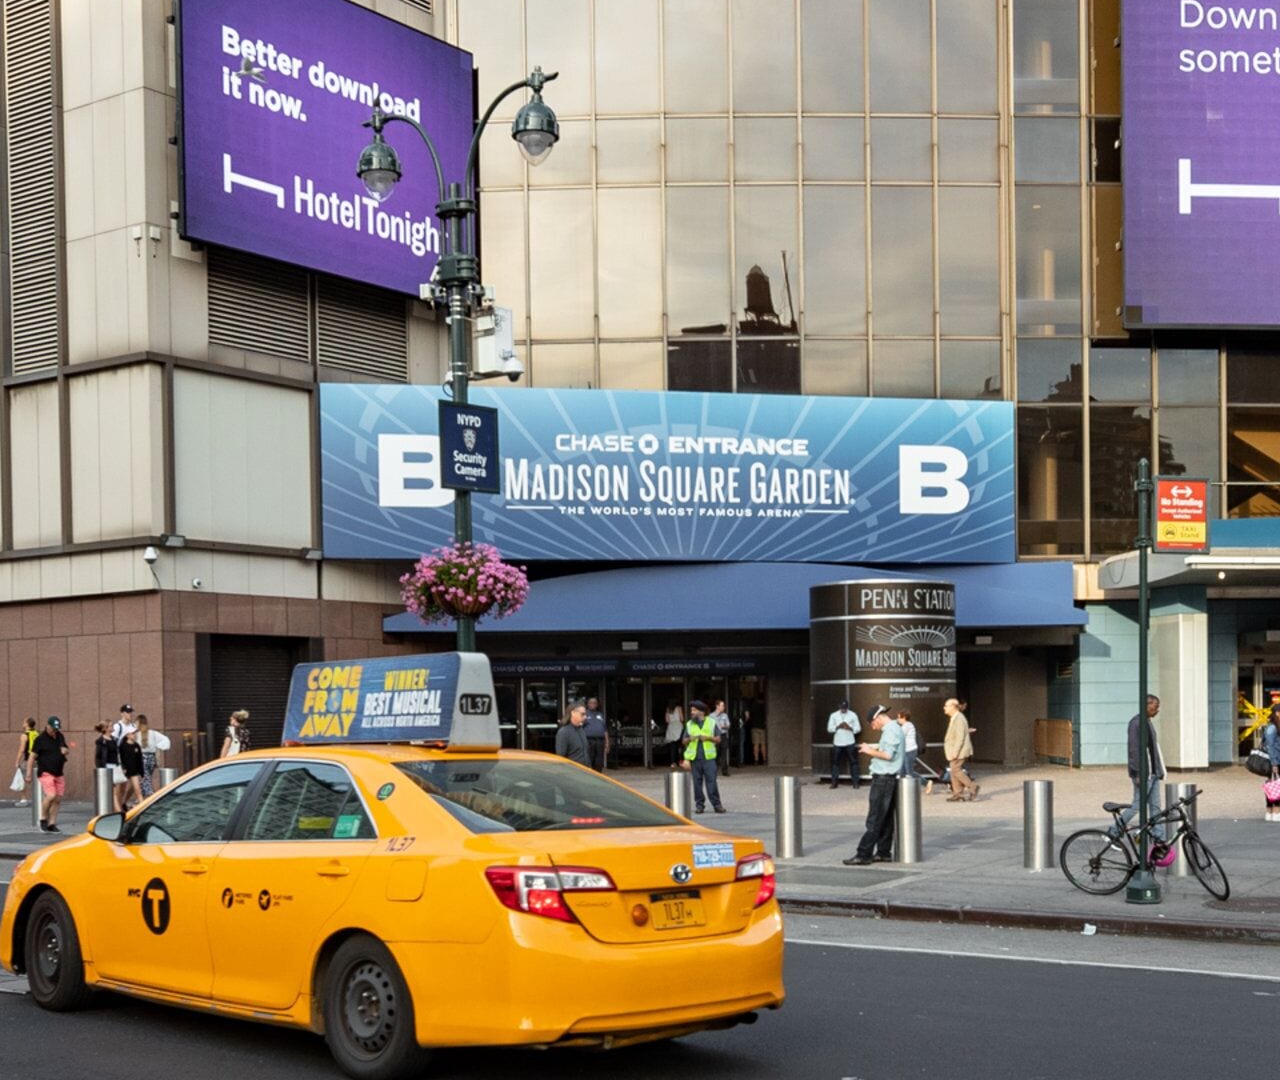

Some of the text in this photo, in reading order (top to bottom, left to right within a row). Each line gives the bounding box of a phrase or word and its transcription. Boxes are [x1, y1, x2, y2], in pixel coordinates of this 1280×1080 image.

[222, 24, 420, 123] Better download
[223, 66, 307, 122] it now.
[294, 175, 447, 257] HotelTonigh
[457, 413, 481, 427] NYPD
[555, 434, 809, 456] CHASE ENTRANCE
[453, 450, 487, 468] Security
[454, 463, 486, 477] Camera
[378, 433, 456, 508] B
[505, 458, 629, 502] MADISON
[639, 460, 741, 505] SQUARE
[898, 444, 970, 515] B
[559, 506, 585, 515] THE
[591, 506, 651, 516] WORLD'S
[657, 507, 694, 516] MOST
[700, 508, 752, 517] FAMOUS
[1173, 498, 1203, 508] Standing
[861, 589, 908, 609] PENN
[856, 648, 905, 667] MADISON
[908, 648, 941, 667] SQUARE
[308, 665, 363, 690] COME
[384, 669, 430, 691] WINNER!
[303, 689, 359, 714] FROM
[364, 690, 442, 716] BEST MUSICAL
[461, 697, 490, 713] 1L37
[299, 712, 357, 738] AWAY
[385, 837, 416, 852] 1L37
[128, 888, 141, 898] NYC
[147, 889, 165, 928] T
